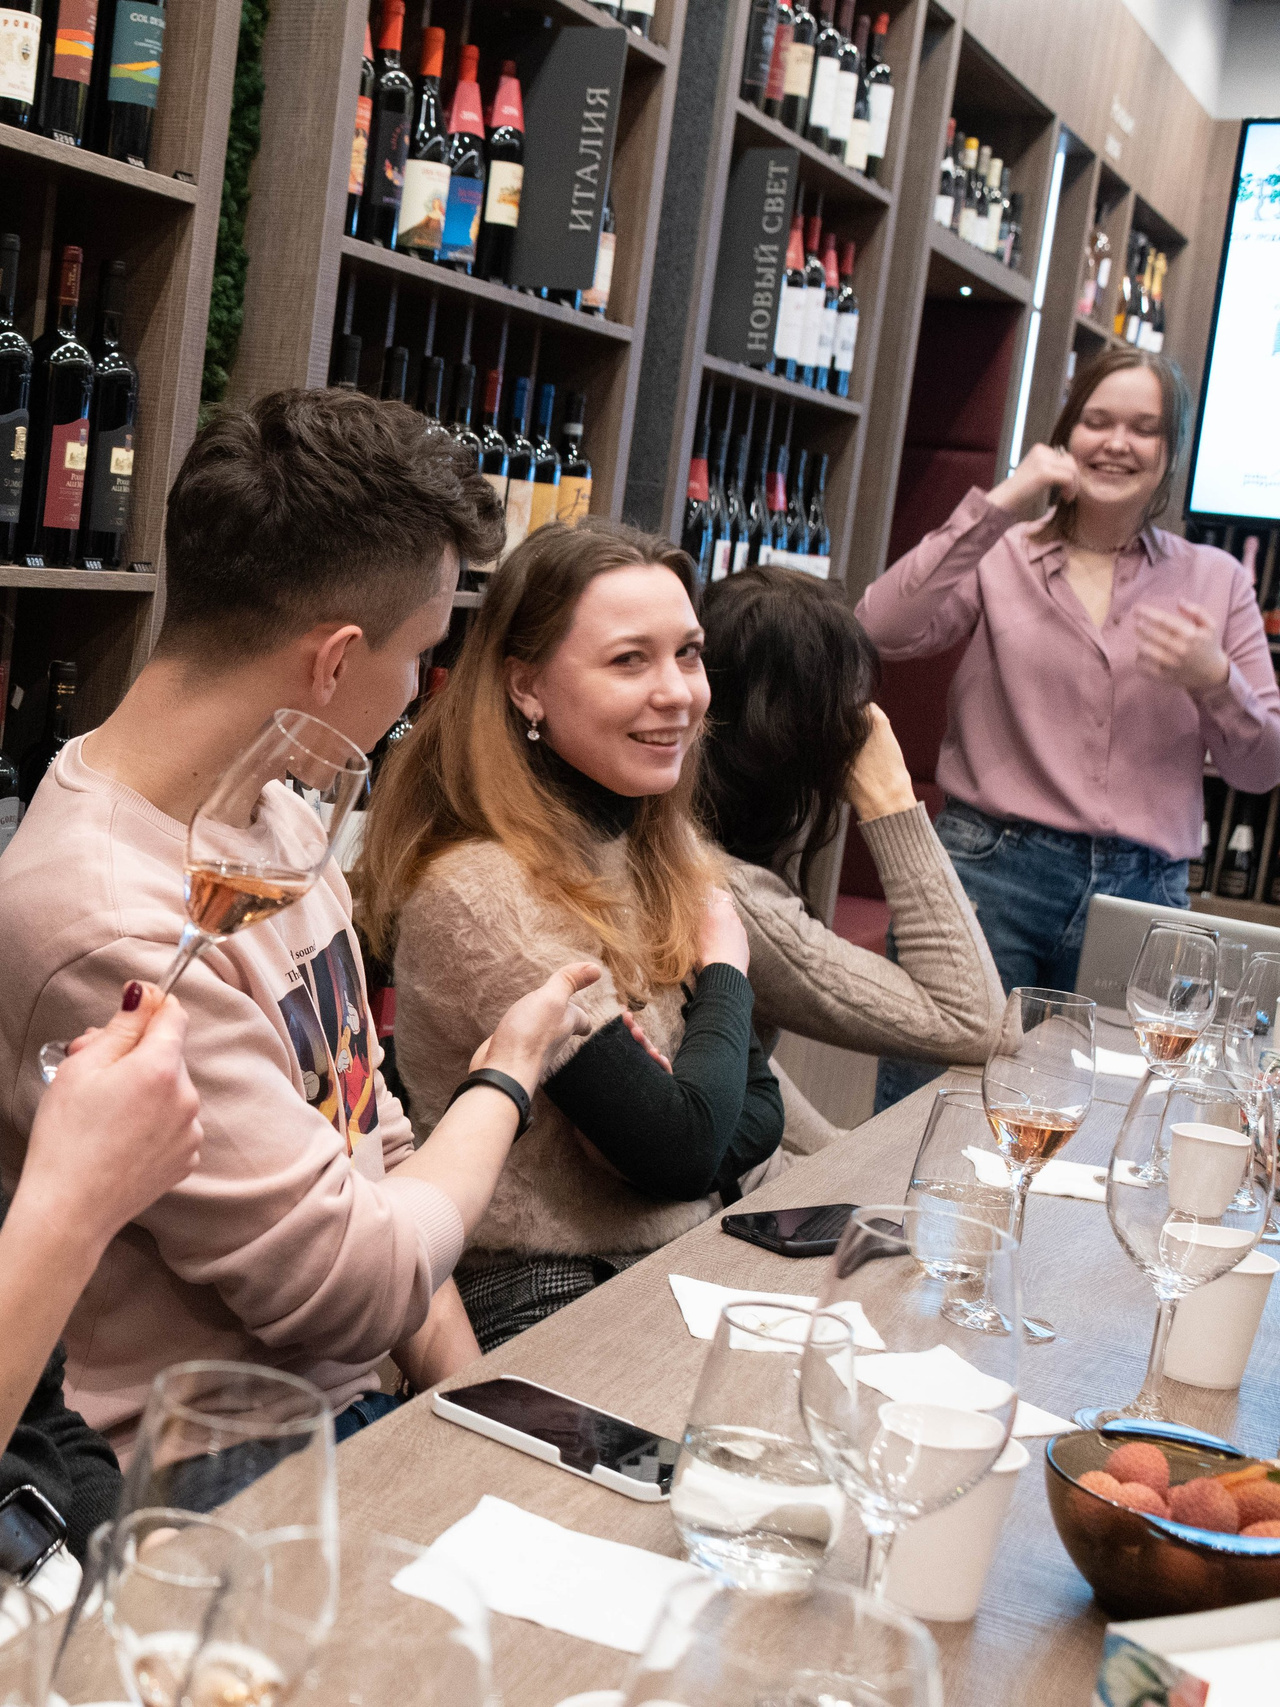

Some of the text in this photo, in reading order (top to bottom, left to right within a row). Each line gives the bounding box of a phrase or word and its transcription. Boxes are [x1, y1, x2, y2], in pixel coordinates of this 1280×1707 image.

[569, 87, 611, 232] ИТАЛИЯ
[747, 160, 789, 351] НОВЫЙ СВЕТ
